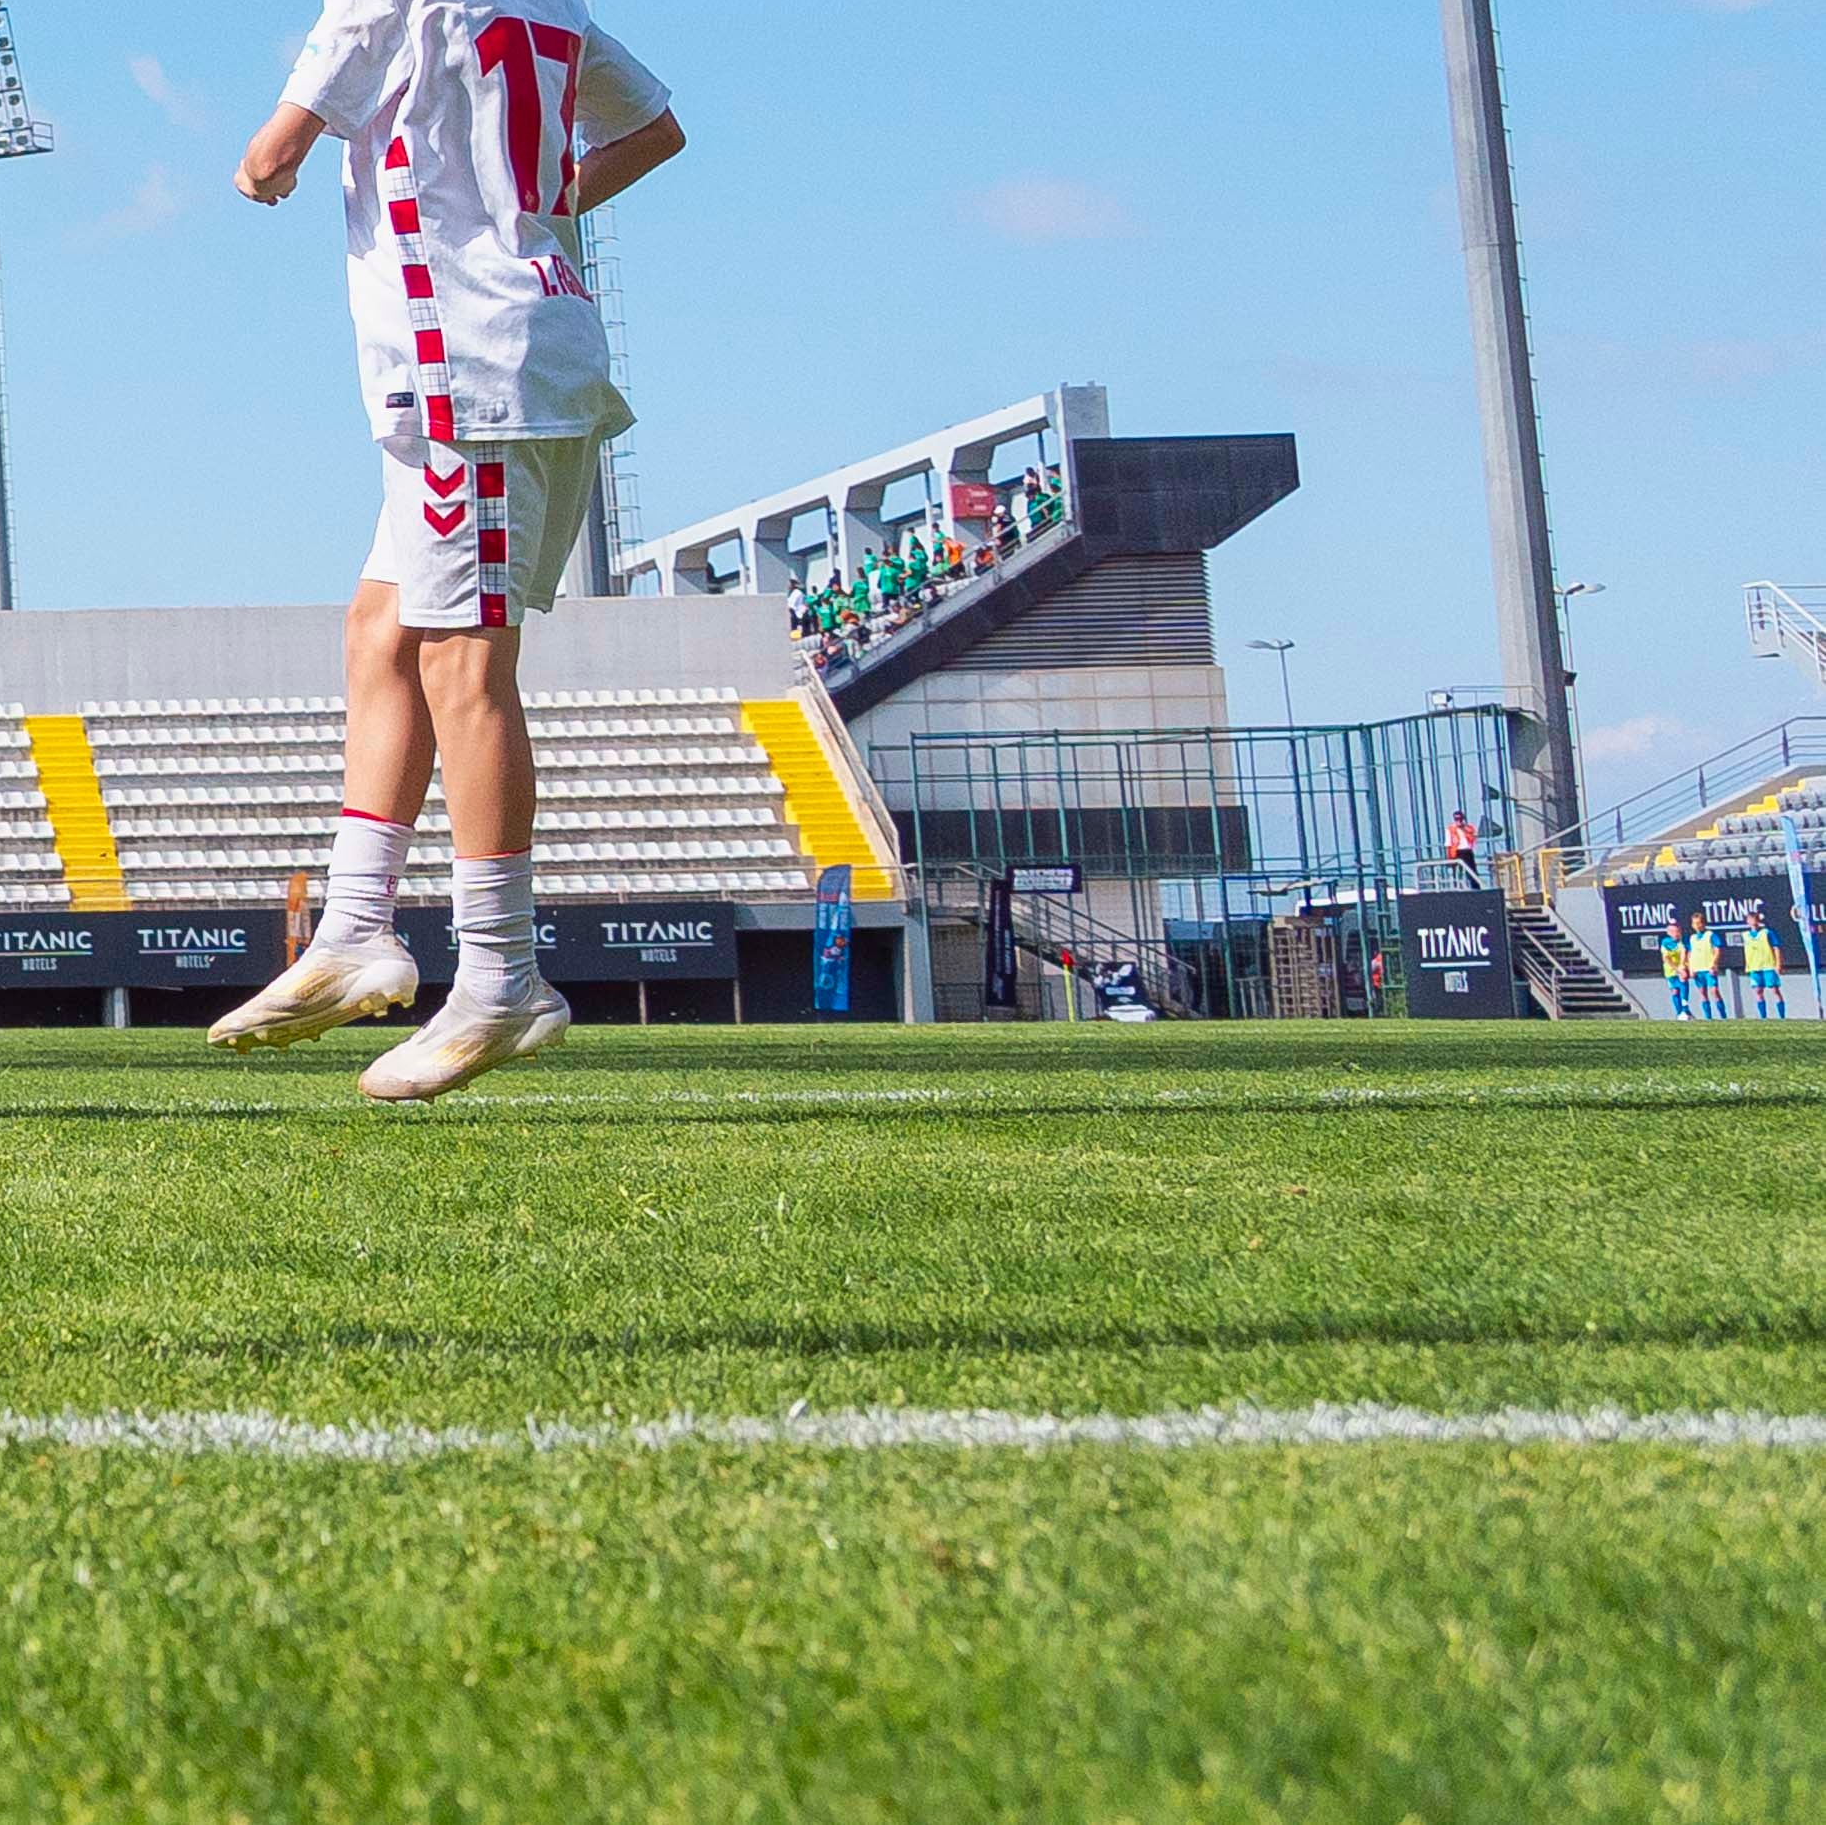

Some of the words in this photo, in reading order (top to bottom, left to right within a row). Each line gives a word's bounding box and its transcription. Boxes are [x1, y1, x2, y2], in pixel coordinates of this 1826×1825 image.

[474, 16, 582, 216] 17
[1619, 903, 1677, 927] TITANIC
[137, 927, 246, 948] TITANIC
[600, 921, 713, 942] TITANIC
[1417, 923, 1490, 959] TITANIC
